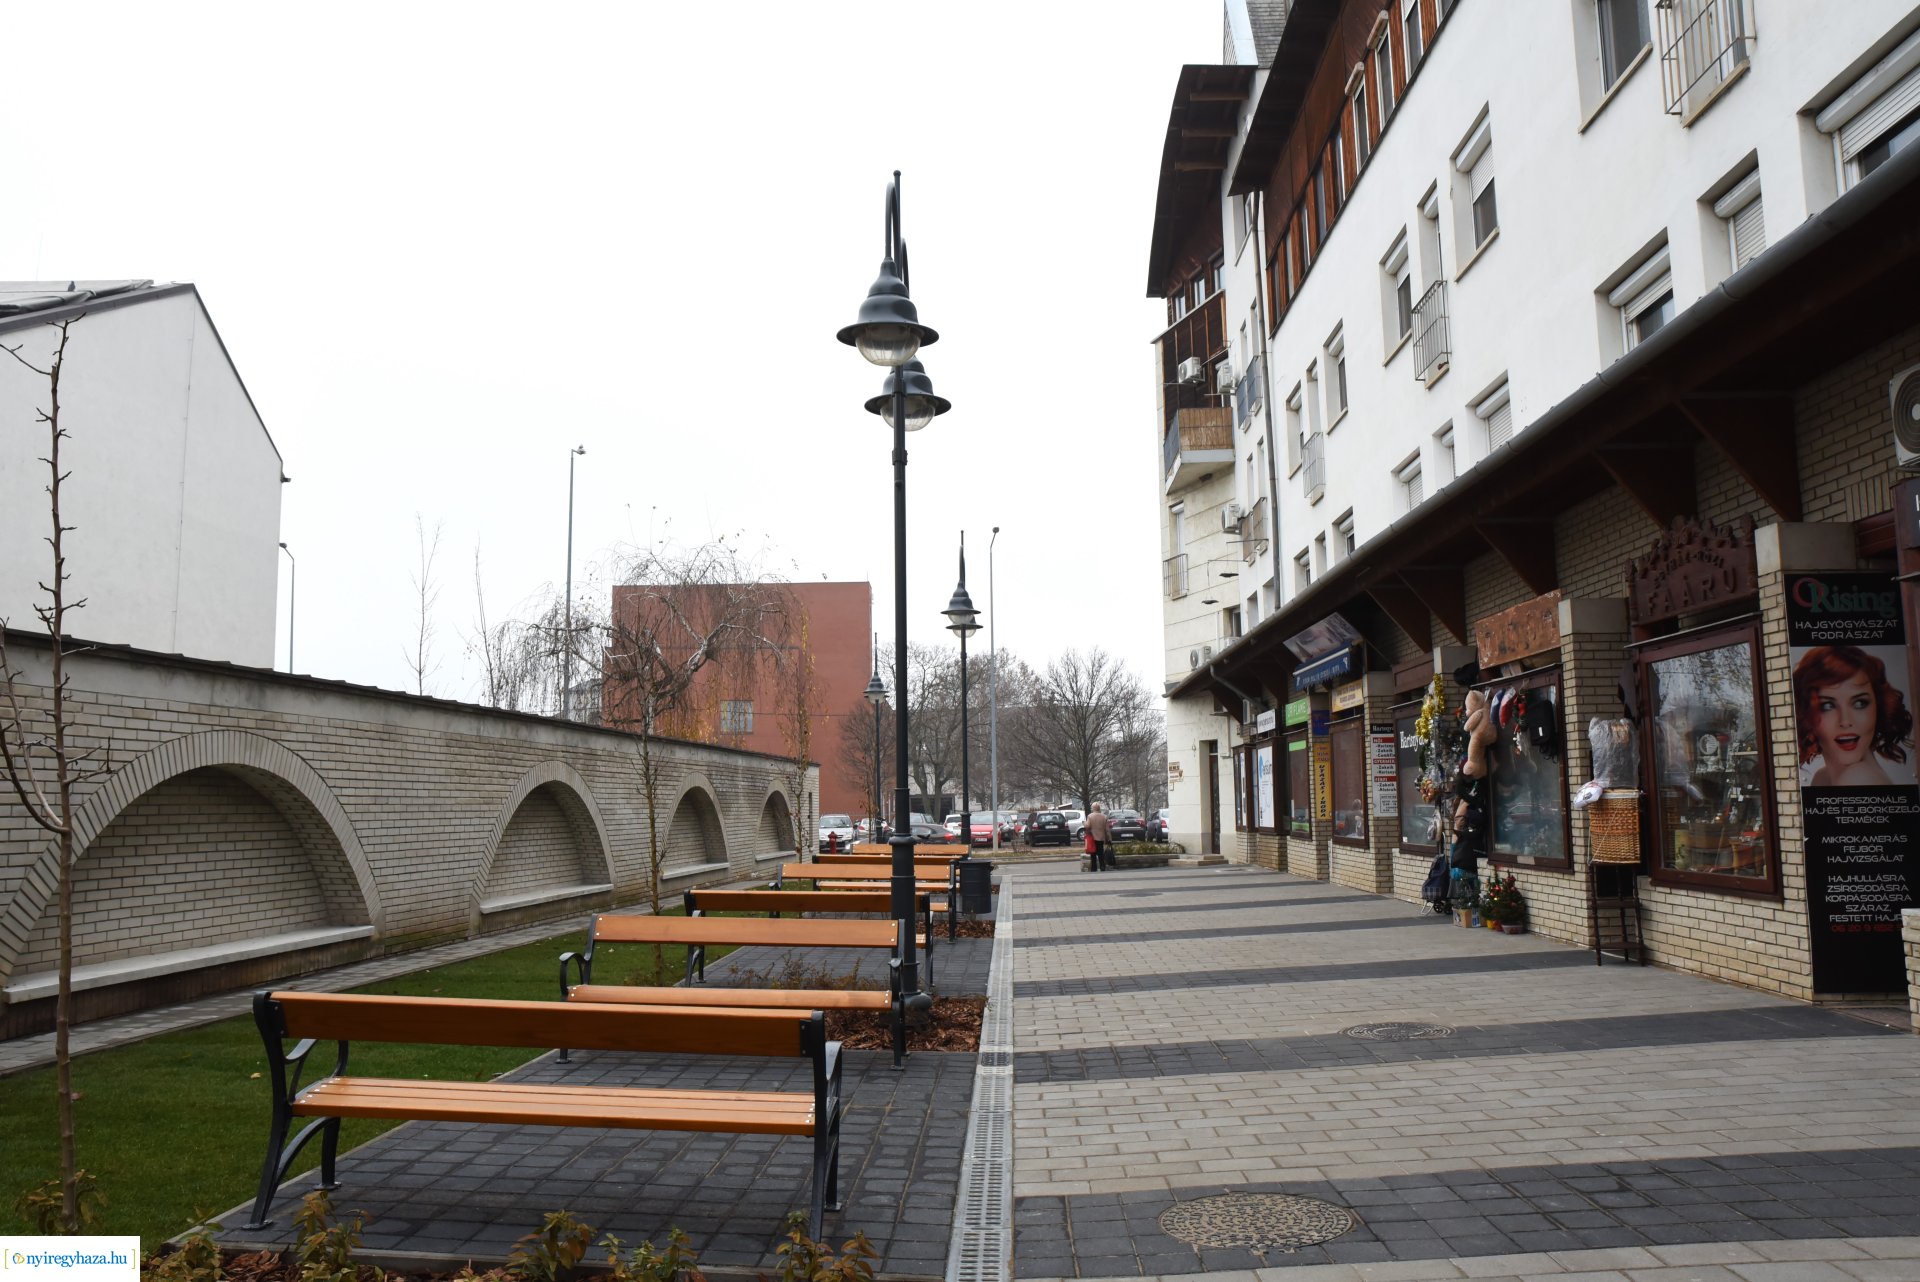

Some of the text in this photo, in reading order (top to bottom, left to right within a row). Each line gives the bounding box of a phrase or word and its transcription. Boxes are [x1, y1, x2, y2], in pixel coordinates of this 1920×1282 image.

[1646, 566, 1738, 616] FAÁRU
[1795, 618, 1898, 630] HAJGYÓGYÁSZAT
[1811, 630, 1885, 640] FODRÁSZAT
[1816, 796, 1907, 805] PROFESSZIONÁLIS
[1835, 815, 1890, 824] TERMÉKEK
[1821, 835, 1908, 844] MIKROKAMERÁS
[1827, 854, 1904, 863] HAJVIZSGÁLAT
[1828, 874, 1906, 883] HAJHULLÁSRA
[1827, 883, 1909, 893] ZSÍROSODÁSRA
[1825, 893, 1912, 903] KORPÁSODÁSRA
[1845, 903, 1891, 912] SZÁRAZ,
[1829, 914, 1873, 922] FESTETT
